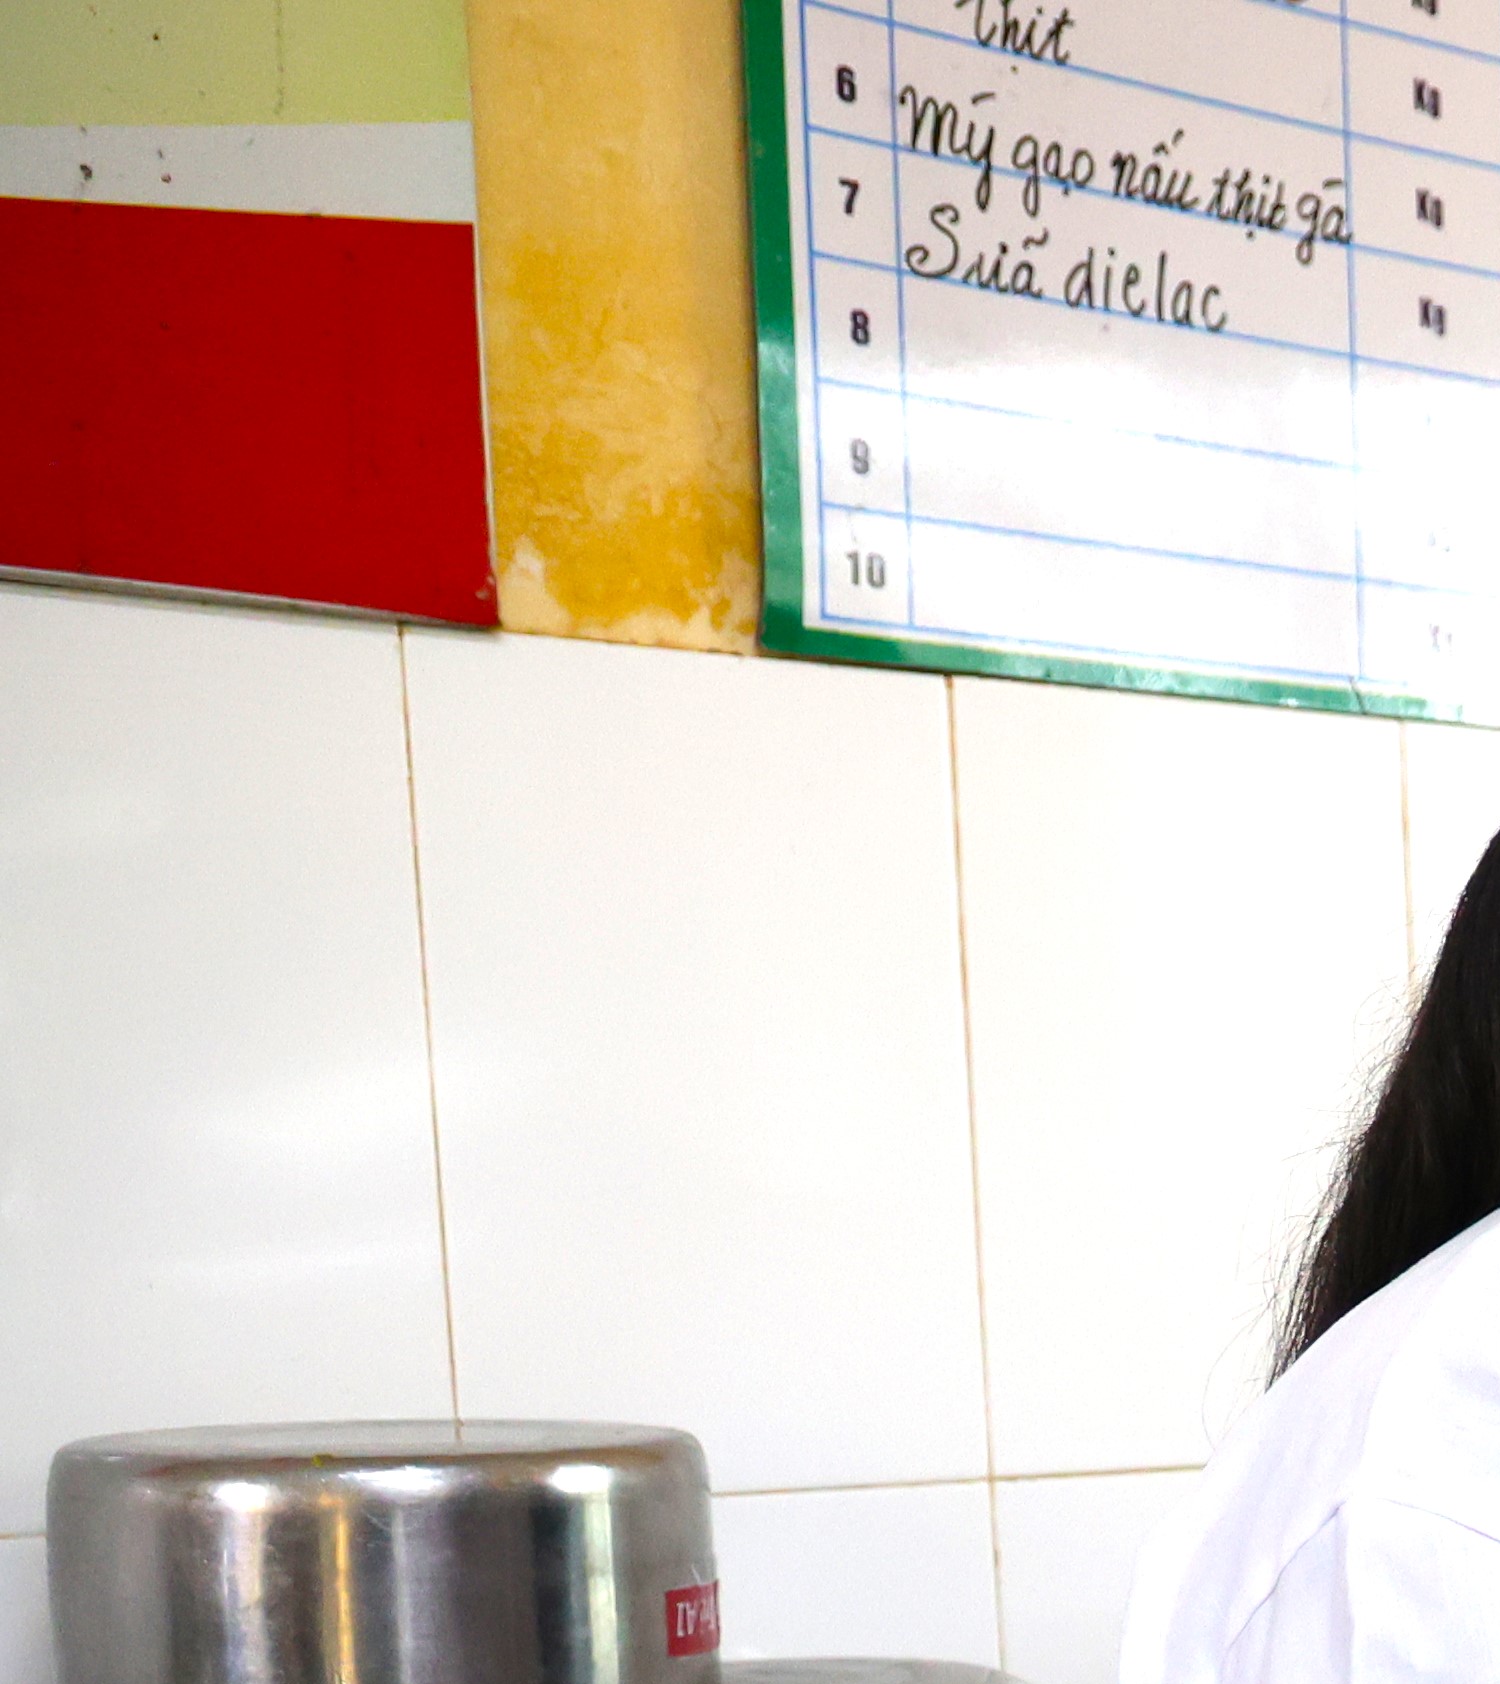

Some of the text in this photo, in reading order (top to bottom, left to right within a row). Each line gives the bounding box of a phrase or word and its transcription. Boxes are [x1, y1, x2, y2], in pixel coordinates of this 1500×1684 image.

[835, 63, 859, 104] 6
[837, 176, 861, 216] 7
[849, 308, 871, 348] 8
[848, 436, 871, 477] 9
[845, 550, 888, 591] 10
